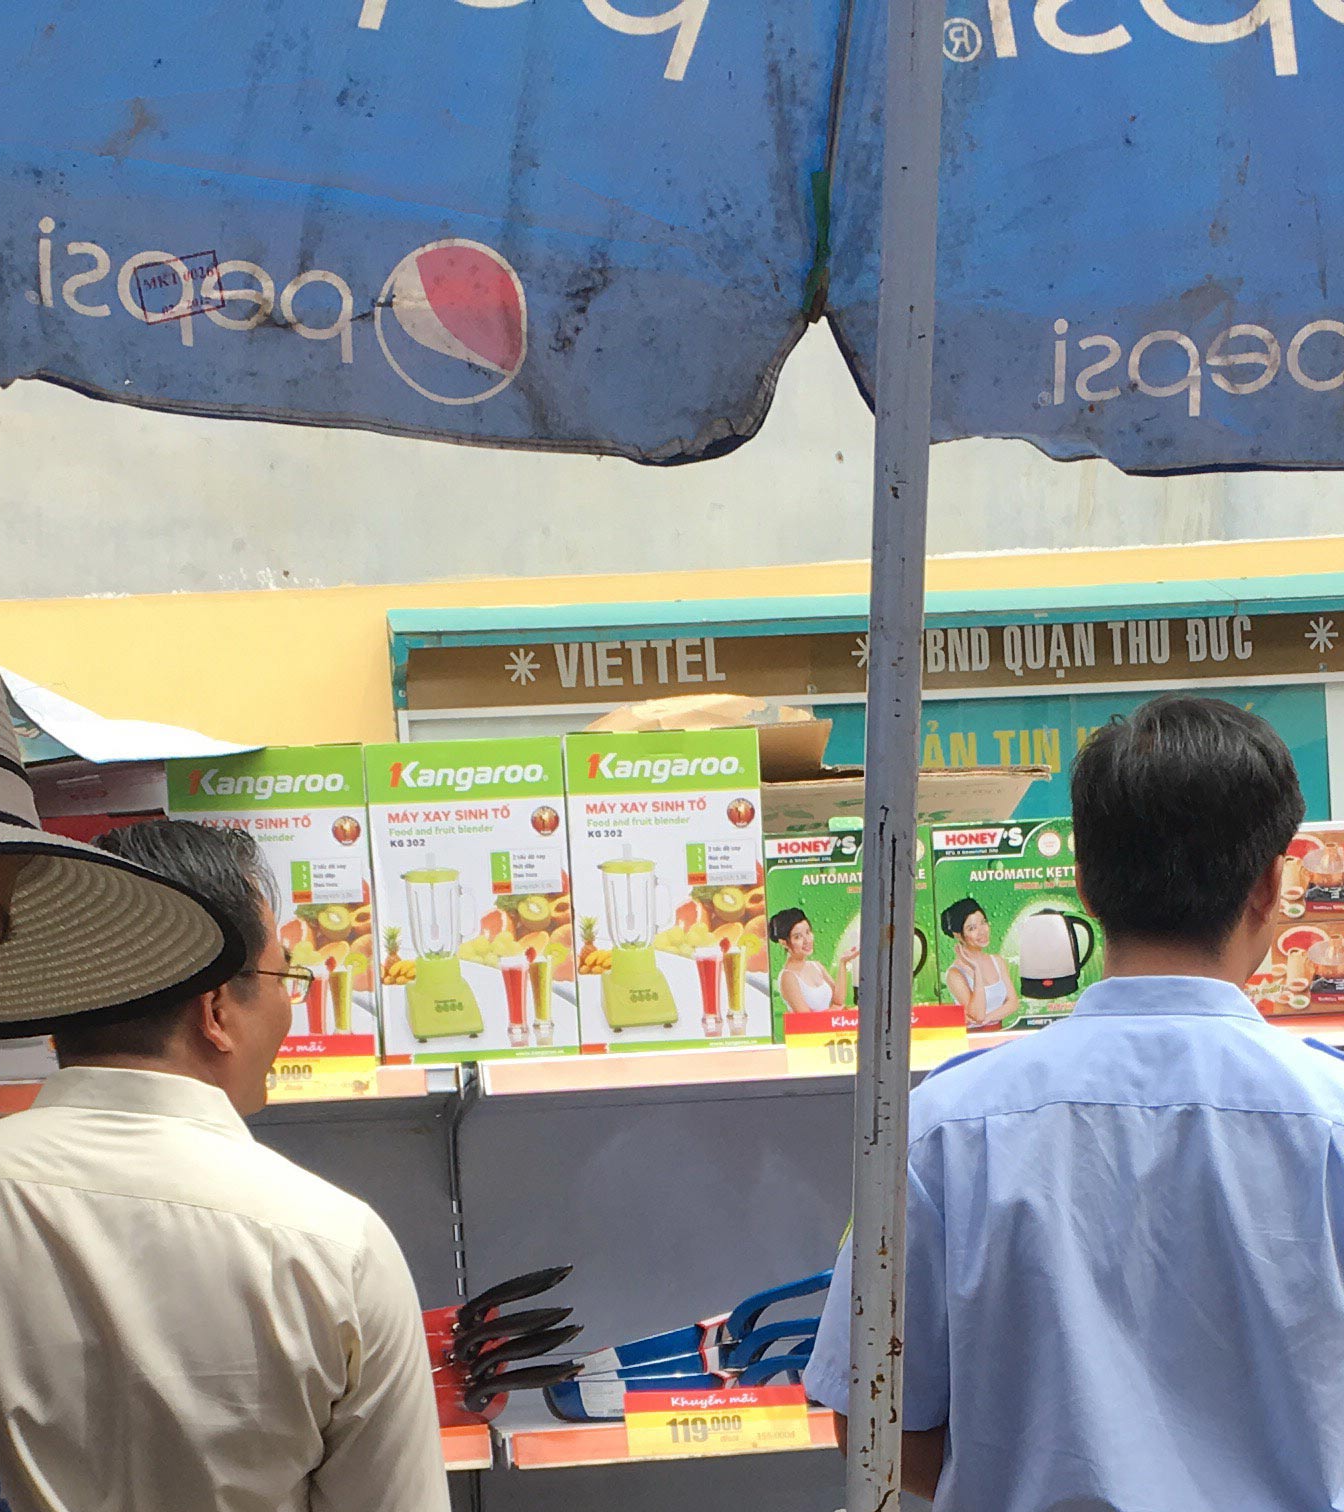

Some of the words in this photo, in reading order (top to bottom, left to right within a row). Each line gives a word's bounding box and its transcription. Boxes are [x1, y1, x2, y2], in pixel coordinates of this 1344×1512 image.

[554, 636, 726, 689] VIETTEL
[925, 625, 991, 673] BND
[921, 719, 978, 768] ẢN
[993, 727, 1061, 773] TIN
[388, 761, 544, 792] Kangaroo
[586, 752, 740, 783] Kangaroo
[188, 768, 344, 799] Kangaroo
[422, 809, 452, 822] XAY
[456, 808, 488, 821] SINH
[620, 801, 648, 814] XAY
[651, 800, 685, 812] SINH
[255, 817, 289, 830] SINH
[802, 872, 862, 886] AUTOMAT
[969, 868, 1044, 882] AUTOMATIC
[1046, 865, 1076, 878] KETT
[666, 1414, 743, 1444] 119.000
